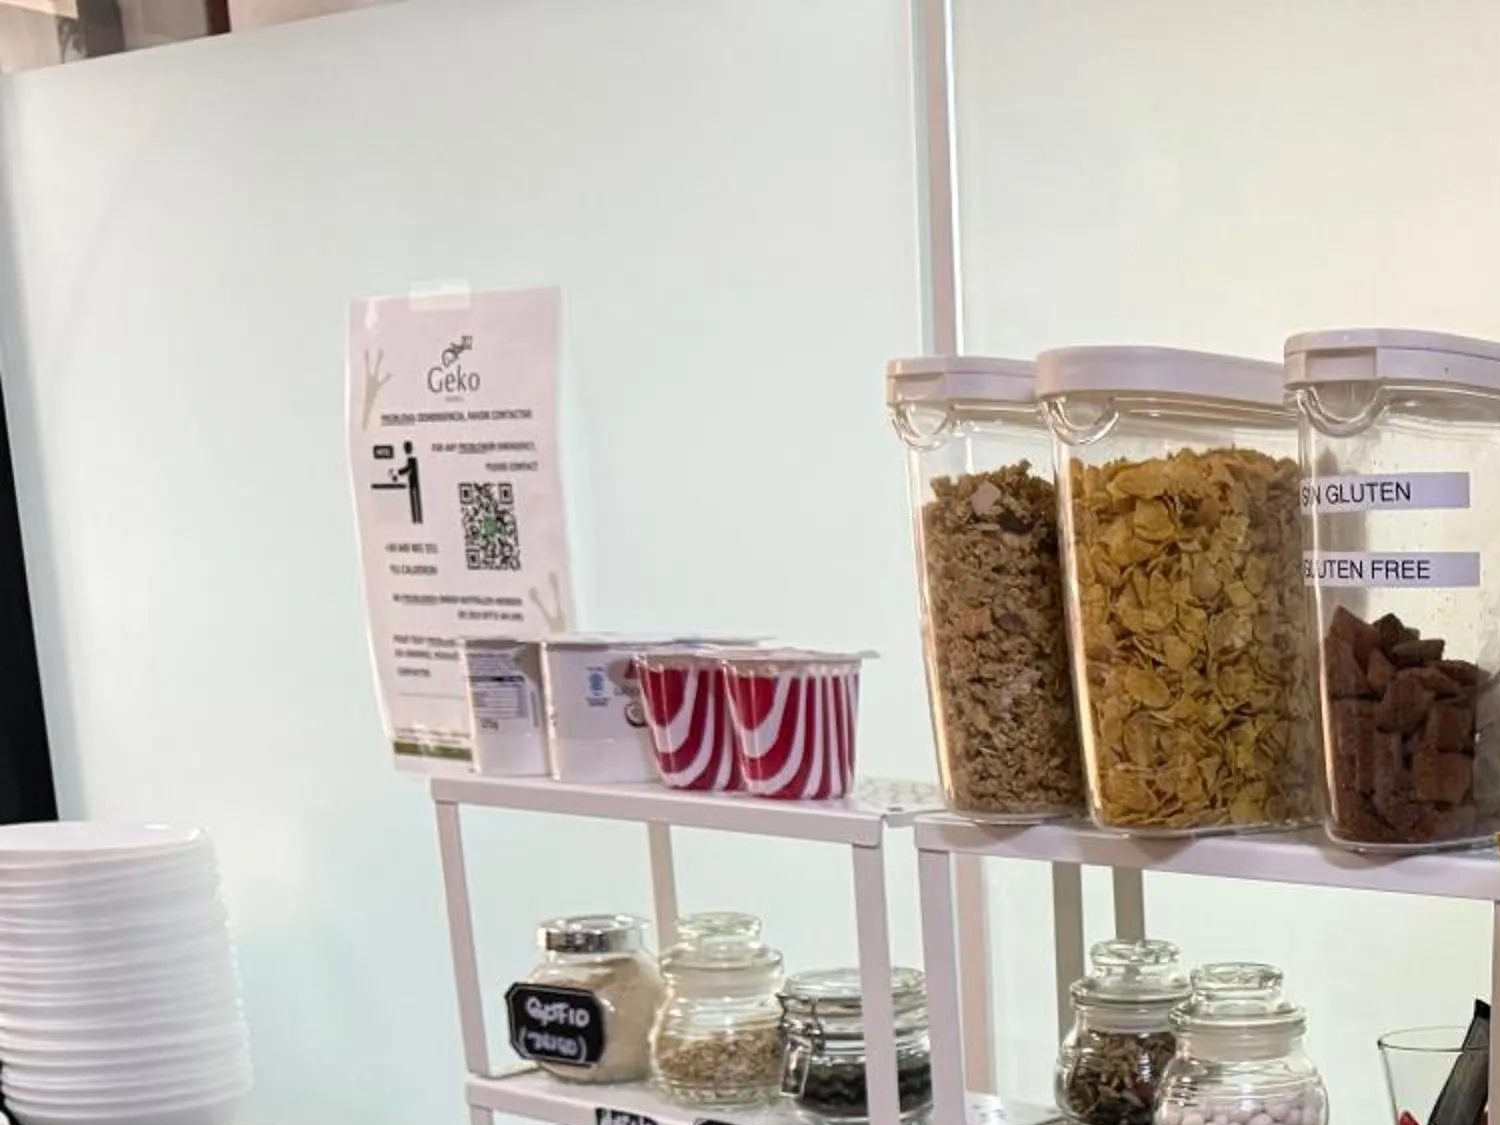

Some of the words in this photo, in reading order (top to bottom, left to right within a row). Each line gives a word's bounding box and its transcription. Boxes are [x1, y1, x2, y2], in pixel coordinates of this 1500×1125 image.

[427, 364, 481, 393] Geko
[1325, 481, 1411, 505] GLUTEN
[1370, 559, 1431, 580] FREE
